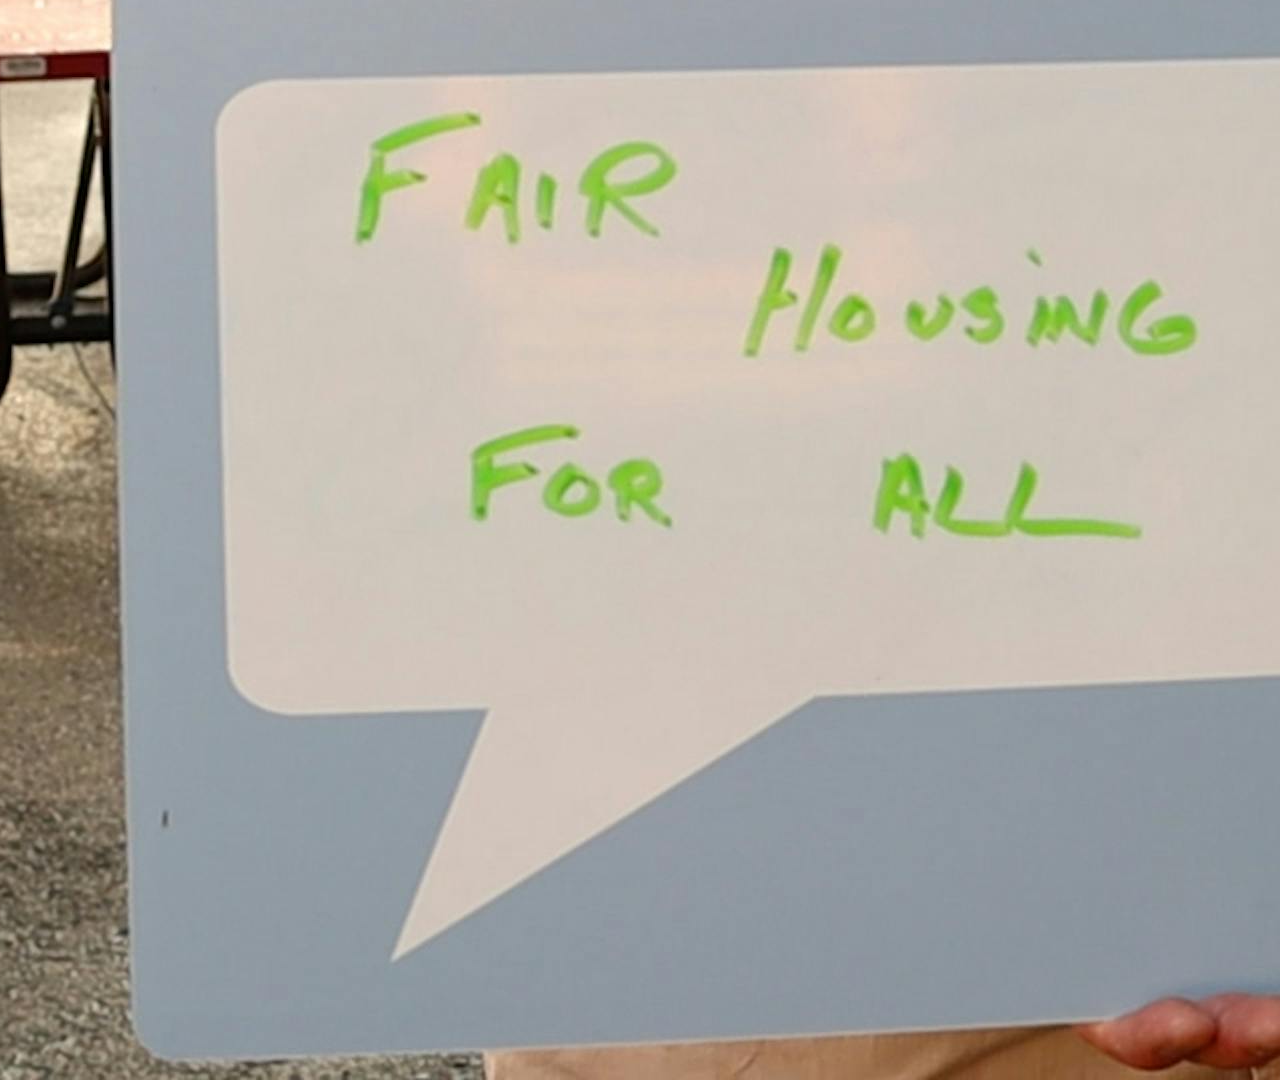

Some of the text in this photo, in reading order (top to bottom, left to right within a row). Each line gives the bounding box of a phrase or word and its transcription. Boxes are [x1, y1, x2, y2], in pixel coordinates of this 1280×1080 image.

[356, 112, 677, 242] FAIR
[472, 424, 1139, 538] FOR ALL
